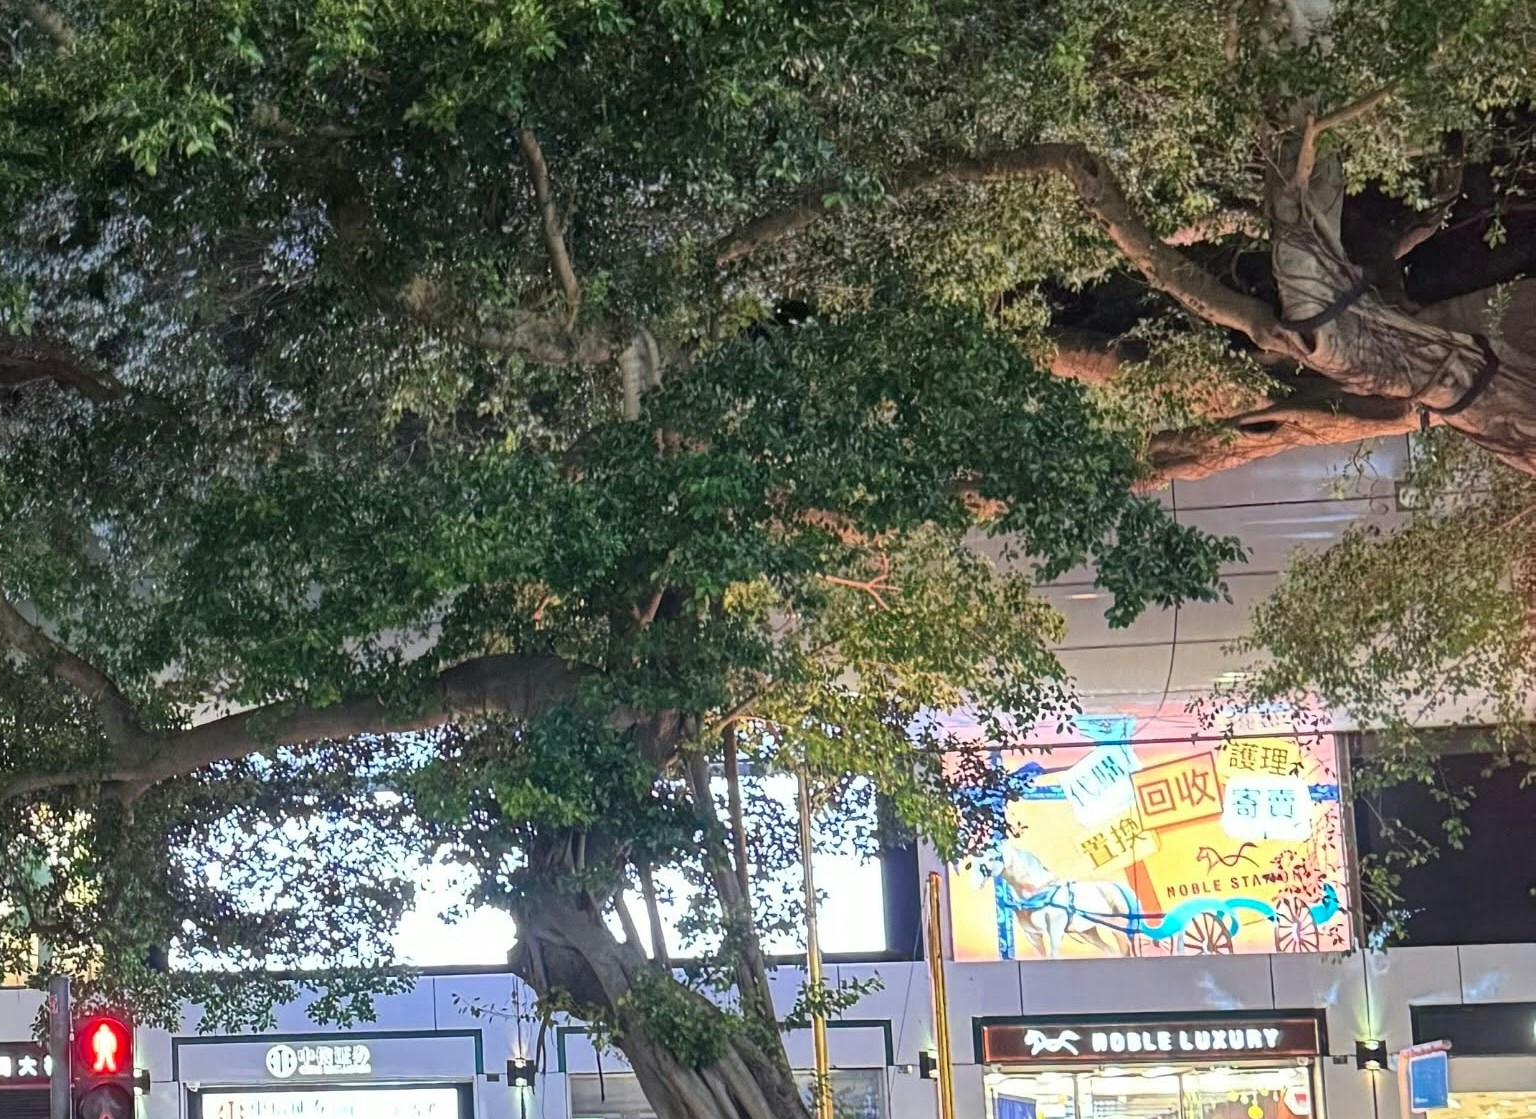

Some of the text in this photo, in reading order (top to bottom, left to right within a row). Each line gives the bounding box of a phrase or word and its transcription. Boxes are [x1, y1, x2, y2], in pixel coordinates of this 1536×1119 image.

[1229, 742, 1288, 776] 護理
[1137, 768, 1216, 817] 回收
[1166, 879, 1222, 899] NOBLE
[1091, 1028, 1280, 1052] NOBLE LUXURY
